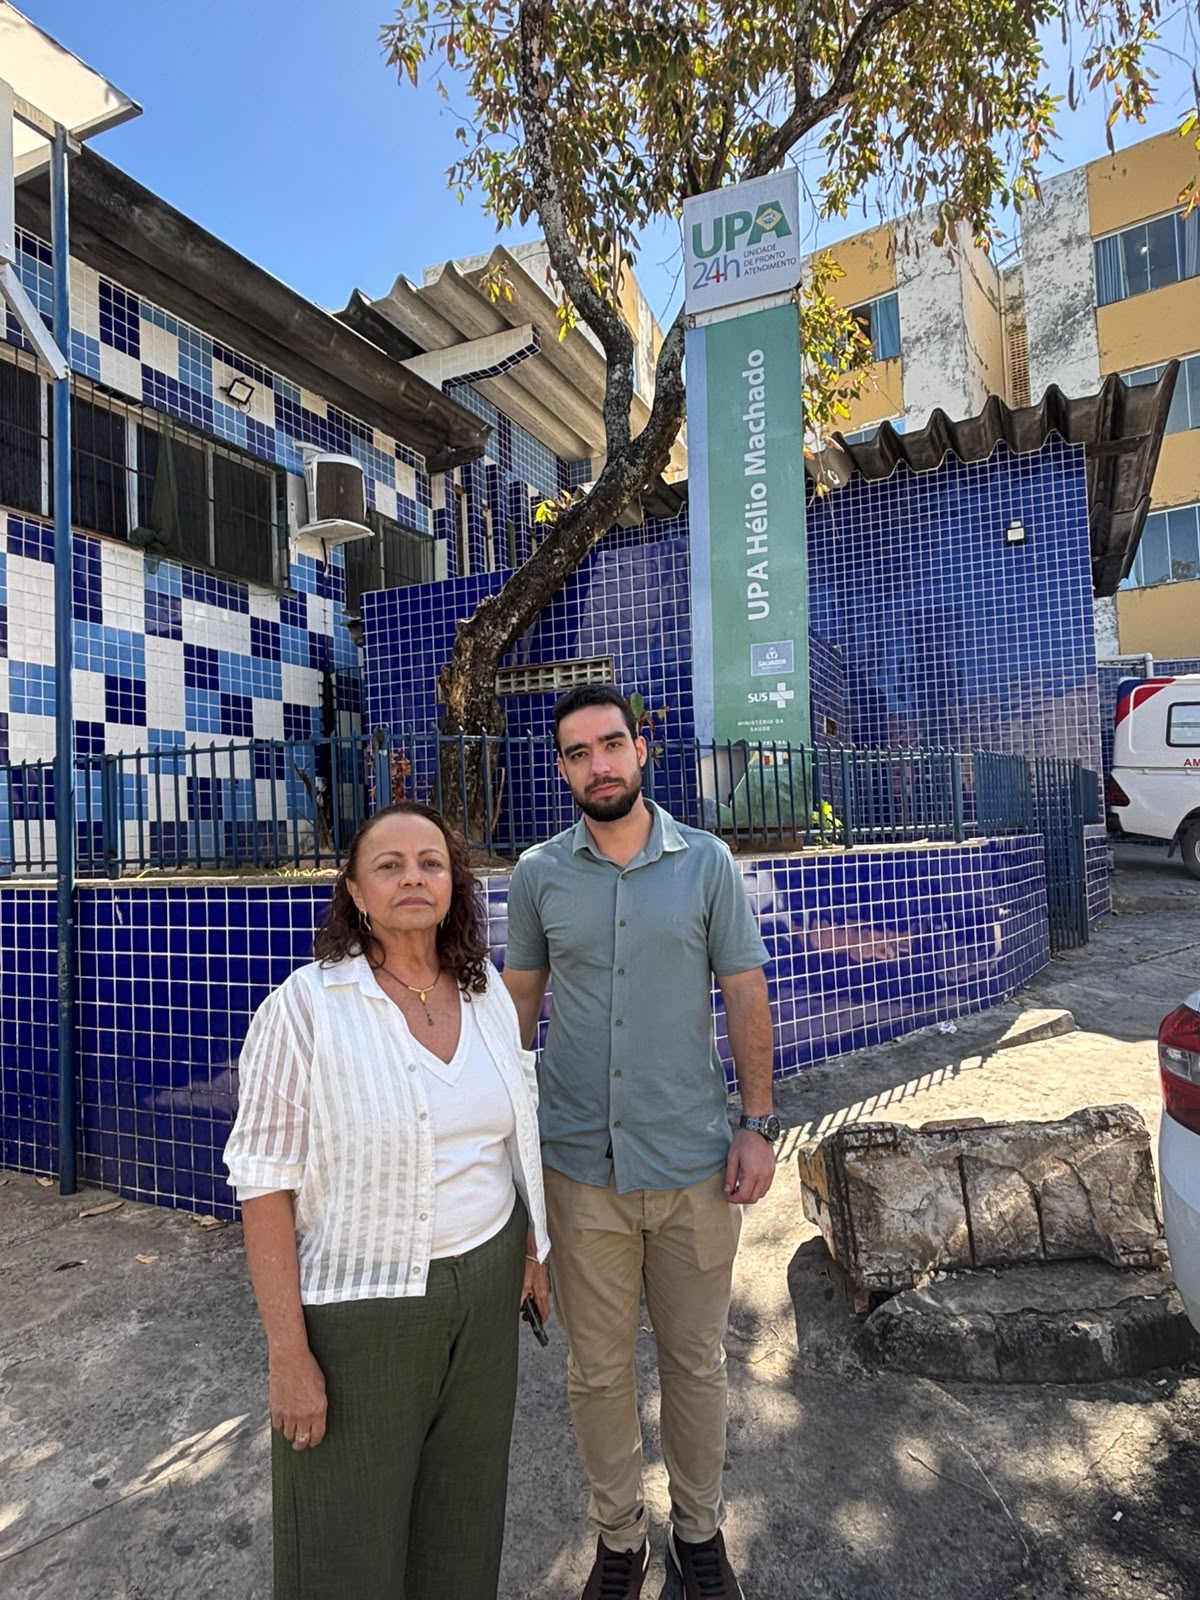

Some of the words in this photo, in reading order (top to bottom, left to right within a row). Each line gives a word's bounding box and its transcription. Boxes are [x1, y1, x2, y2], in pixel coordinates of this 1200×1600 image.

[692, 200, 792, 259] UPA
[743, 243, 777, 258] UNIDADE
[743, 258, 753, 268] DE
[755, 251, 786, 265] PRONTO
[743, 257, 797, 276] ATENDIMENTO
[692, 254, 740, 290] 24h
[742, 349, 767, 476] Machado
[745, 482, 768, 555] Hélio
[746, 560, 770, 621] UPA
[747, 692, 768, 703] SUS
